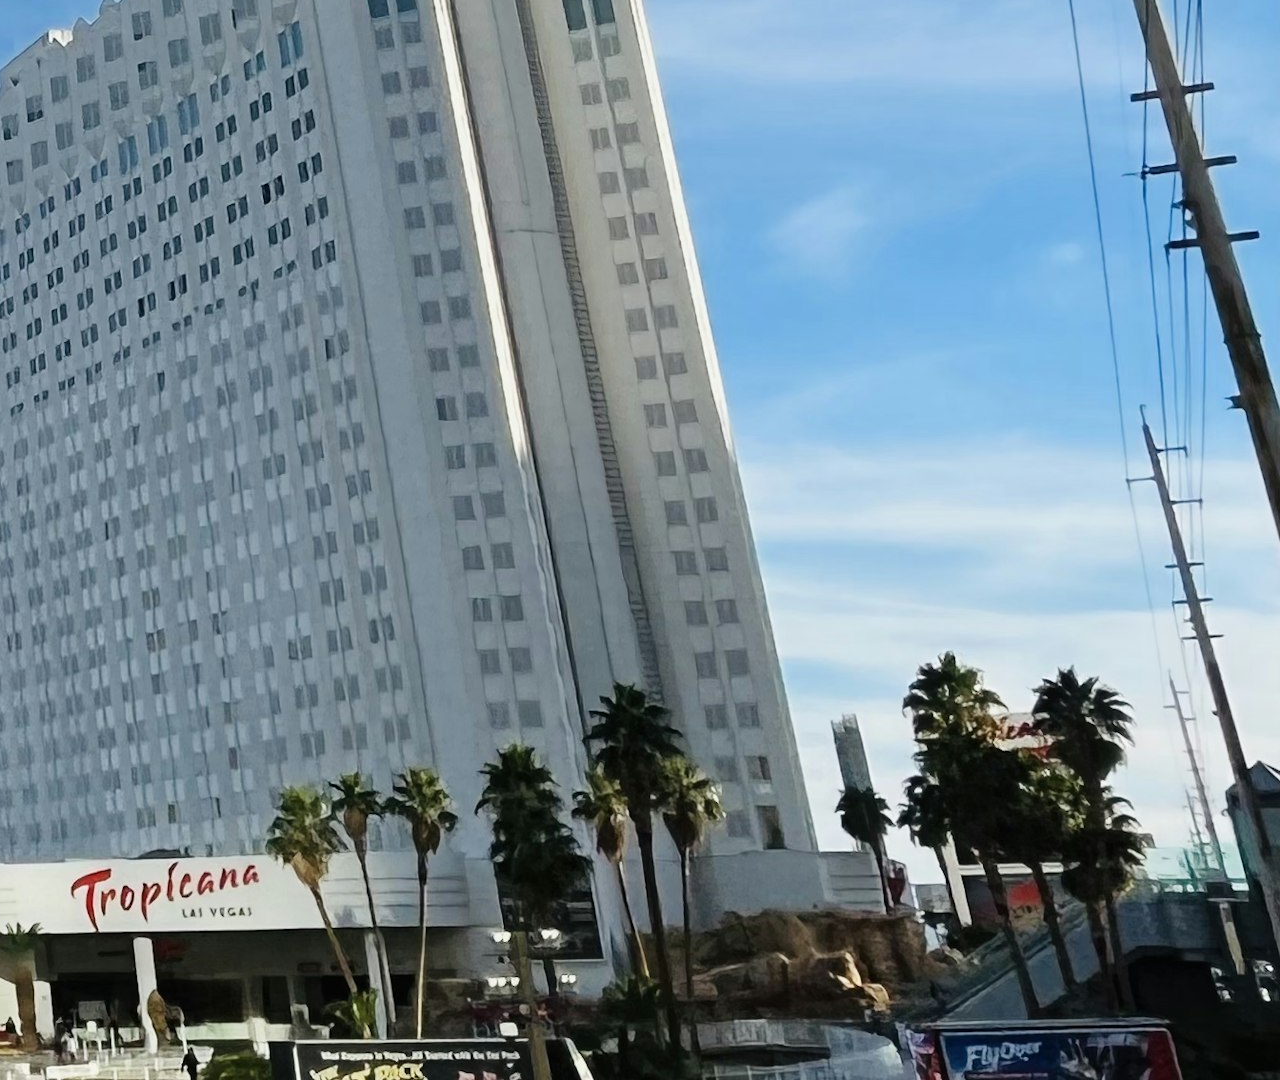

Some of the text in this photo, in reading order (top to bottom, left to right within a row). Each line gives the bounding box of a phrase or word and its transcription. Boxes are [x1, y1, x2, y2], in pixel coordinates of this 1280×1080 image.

[70, 862, 260, 933] Tropicana
[181, 906, 253, 919] LAS VEGAS
